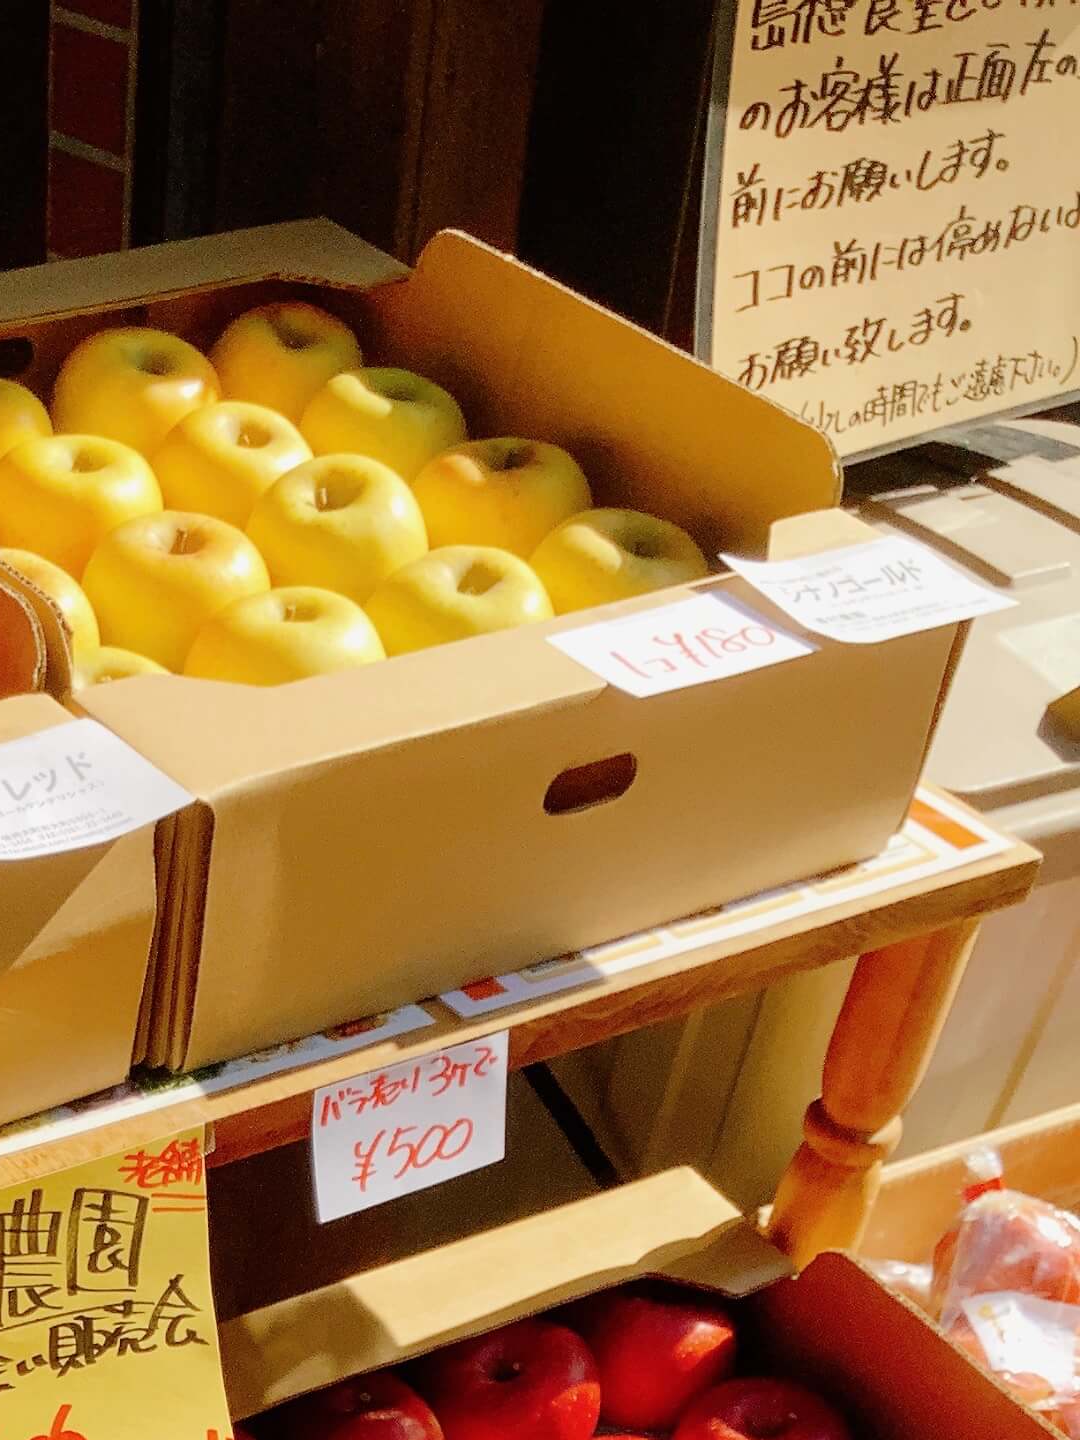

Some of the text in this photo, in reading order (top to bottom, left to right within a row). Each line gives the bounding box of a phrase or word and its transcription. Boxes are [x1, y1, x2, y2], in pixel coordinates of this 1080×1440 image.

[731, 129, 1011, 229] 前にお願いします。
[352, 1118, 473, 1192] ¥500
